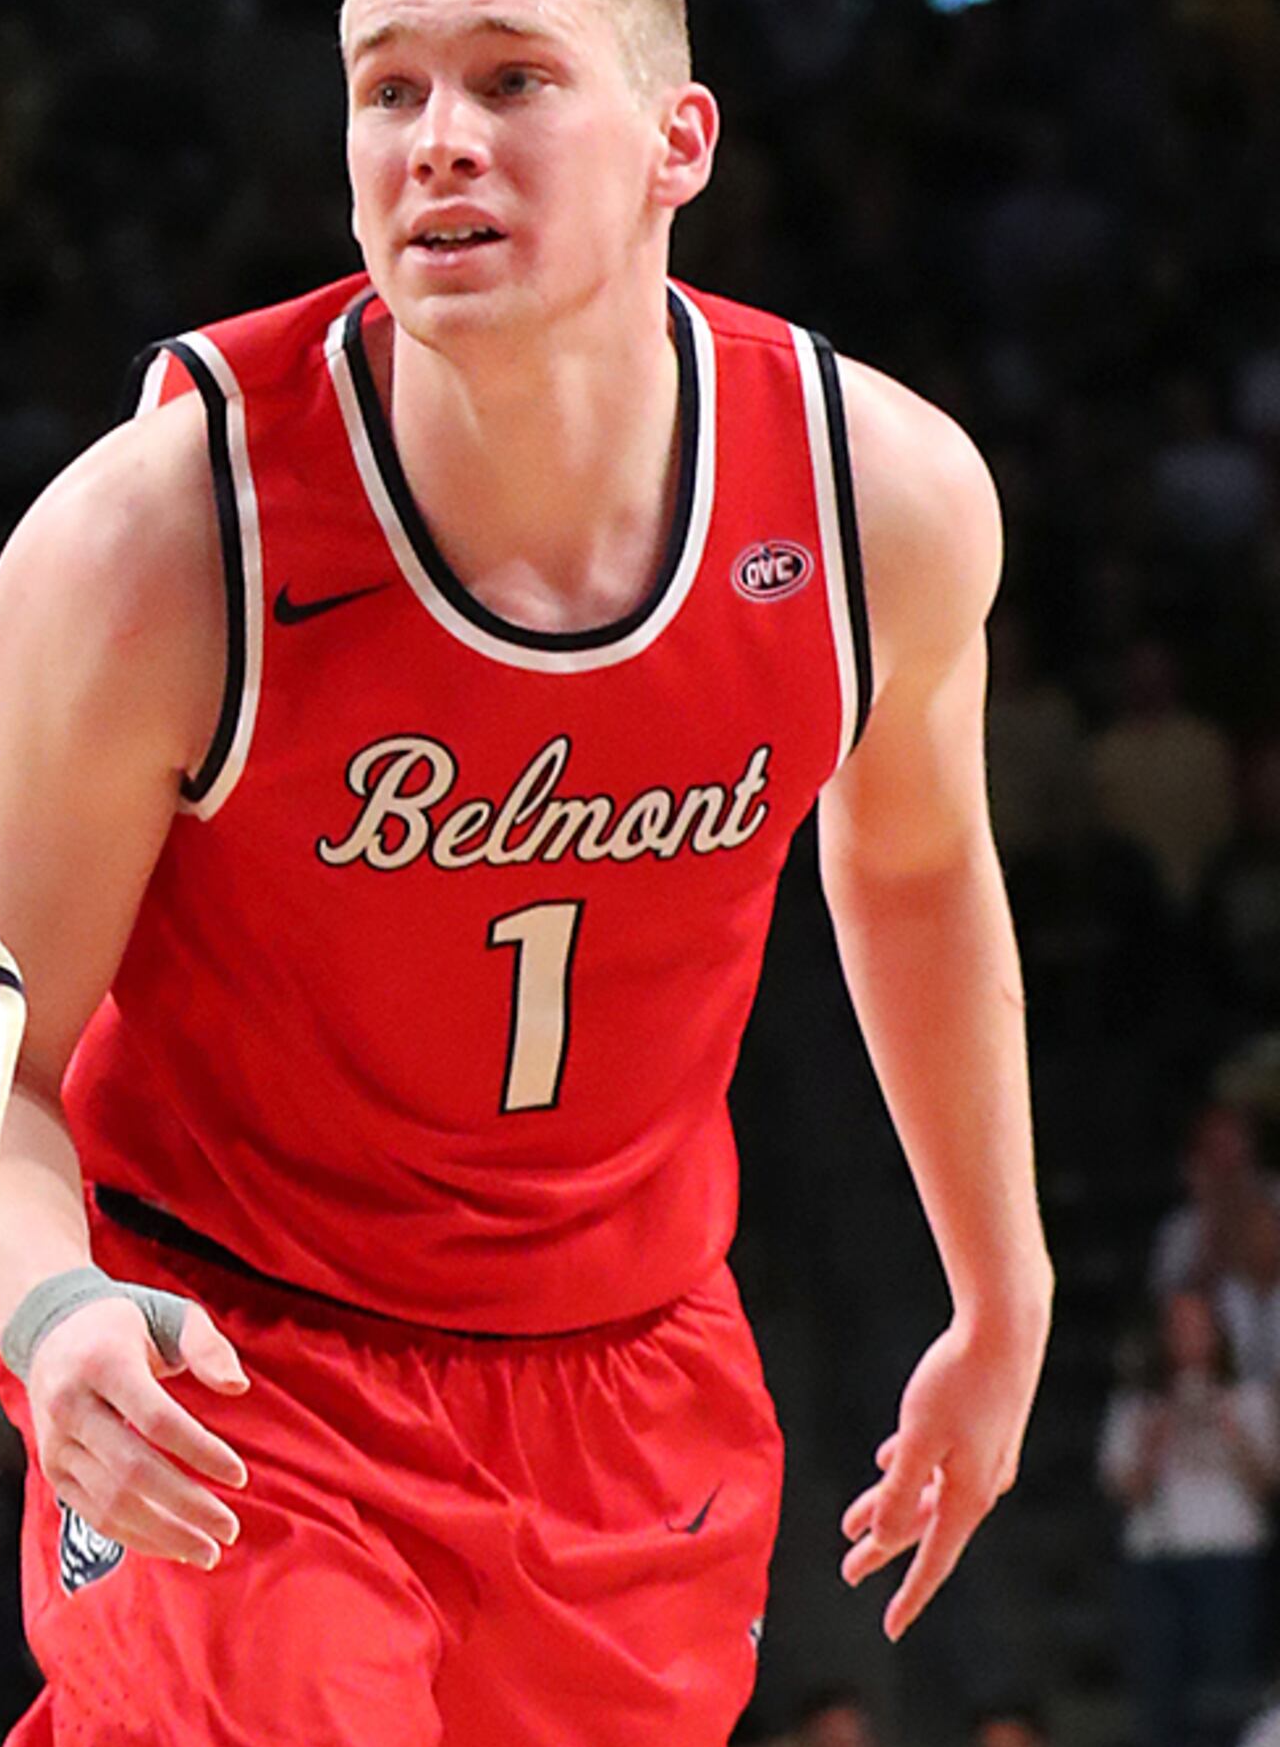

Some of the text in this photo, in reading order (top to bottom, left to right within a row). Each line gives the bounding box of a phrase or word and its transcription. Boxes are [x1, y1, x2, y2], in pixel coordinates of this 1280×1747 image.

[746, 555, 794, 587] OVC
[317, 734, 770, 870] Belmont
[486, 899, 585, 1114] 1
